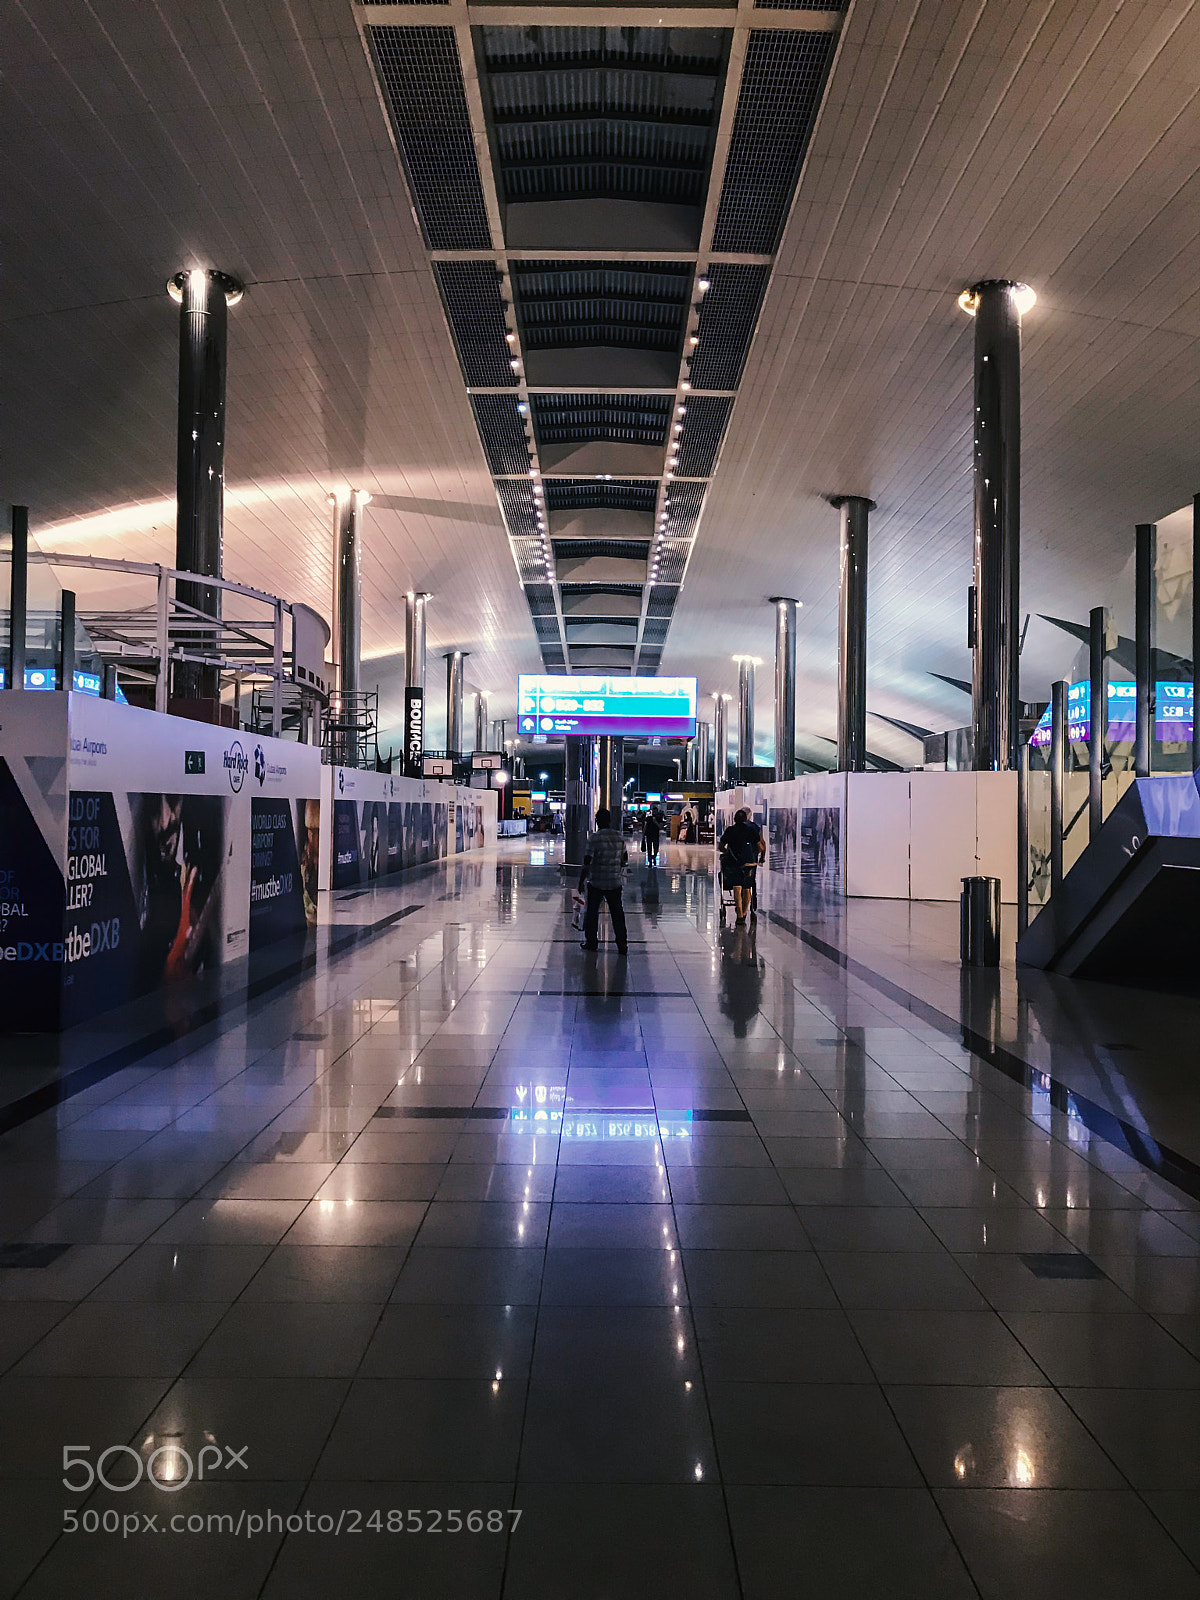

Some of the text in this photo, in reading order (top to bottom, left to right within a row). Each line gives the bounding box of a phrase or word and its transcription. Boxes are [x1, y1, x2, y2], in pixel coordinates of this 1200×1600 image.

[223, 750, 249, 775] Hard Rock
[86, 798, 100, 821] OF
[79, 826, 100, 850] FOR
[68, 853, 108, 881] GLOBAL
